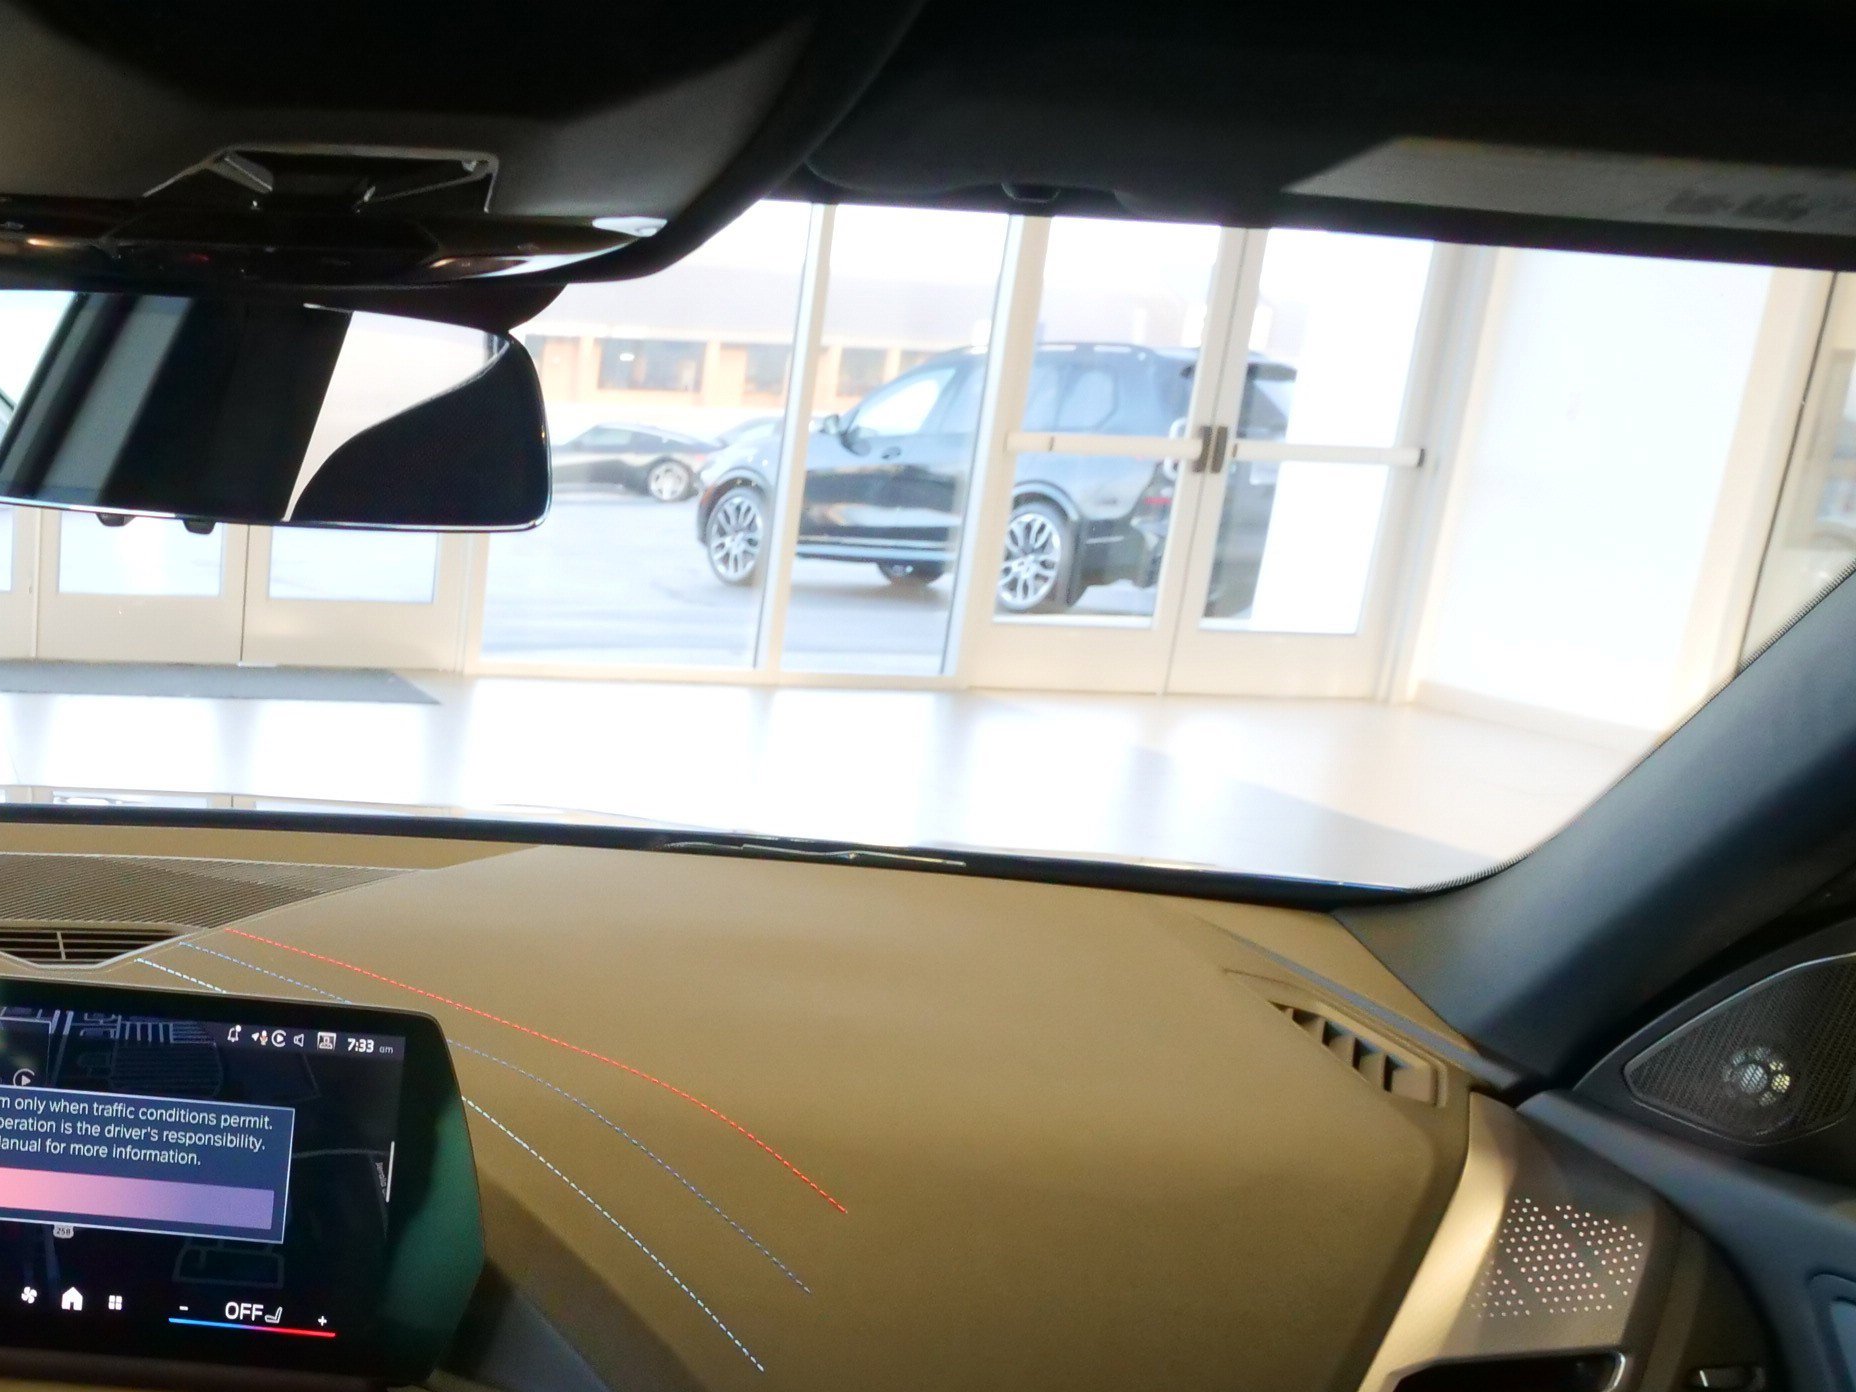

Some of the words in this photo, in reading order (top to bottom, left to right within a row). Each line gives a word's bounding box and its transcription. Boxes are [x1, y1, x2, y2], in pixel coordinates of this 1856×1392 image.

[346, 1037, 375, 1053] 7:33
[14, 1095, 46, 1115] only
[48, 1098, 89, 1115] when
[92, 1100, 135, 1119] traffic
[138, 1106, 218, 1126] conditions
[219, 1113, 274, 1131] permit.
[60, 1118, 73, 1136] is
[76, 1120, 101, 1137] the
[104, 1122, 159, 1142] driver's
[162, 1128, 266, 1154] responsibility.
[45, 1137, 66, 1155] for
[69, 1142, 109, 1158] more
[111, 1143, 202, 1166] information.
[224, 1301, 264, 1321] OFF
